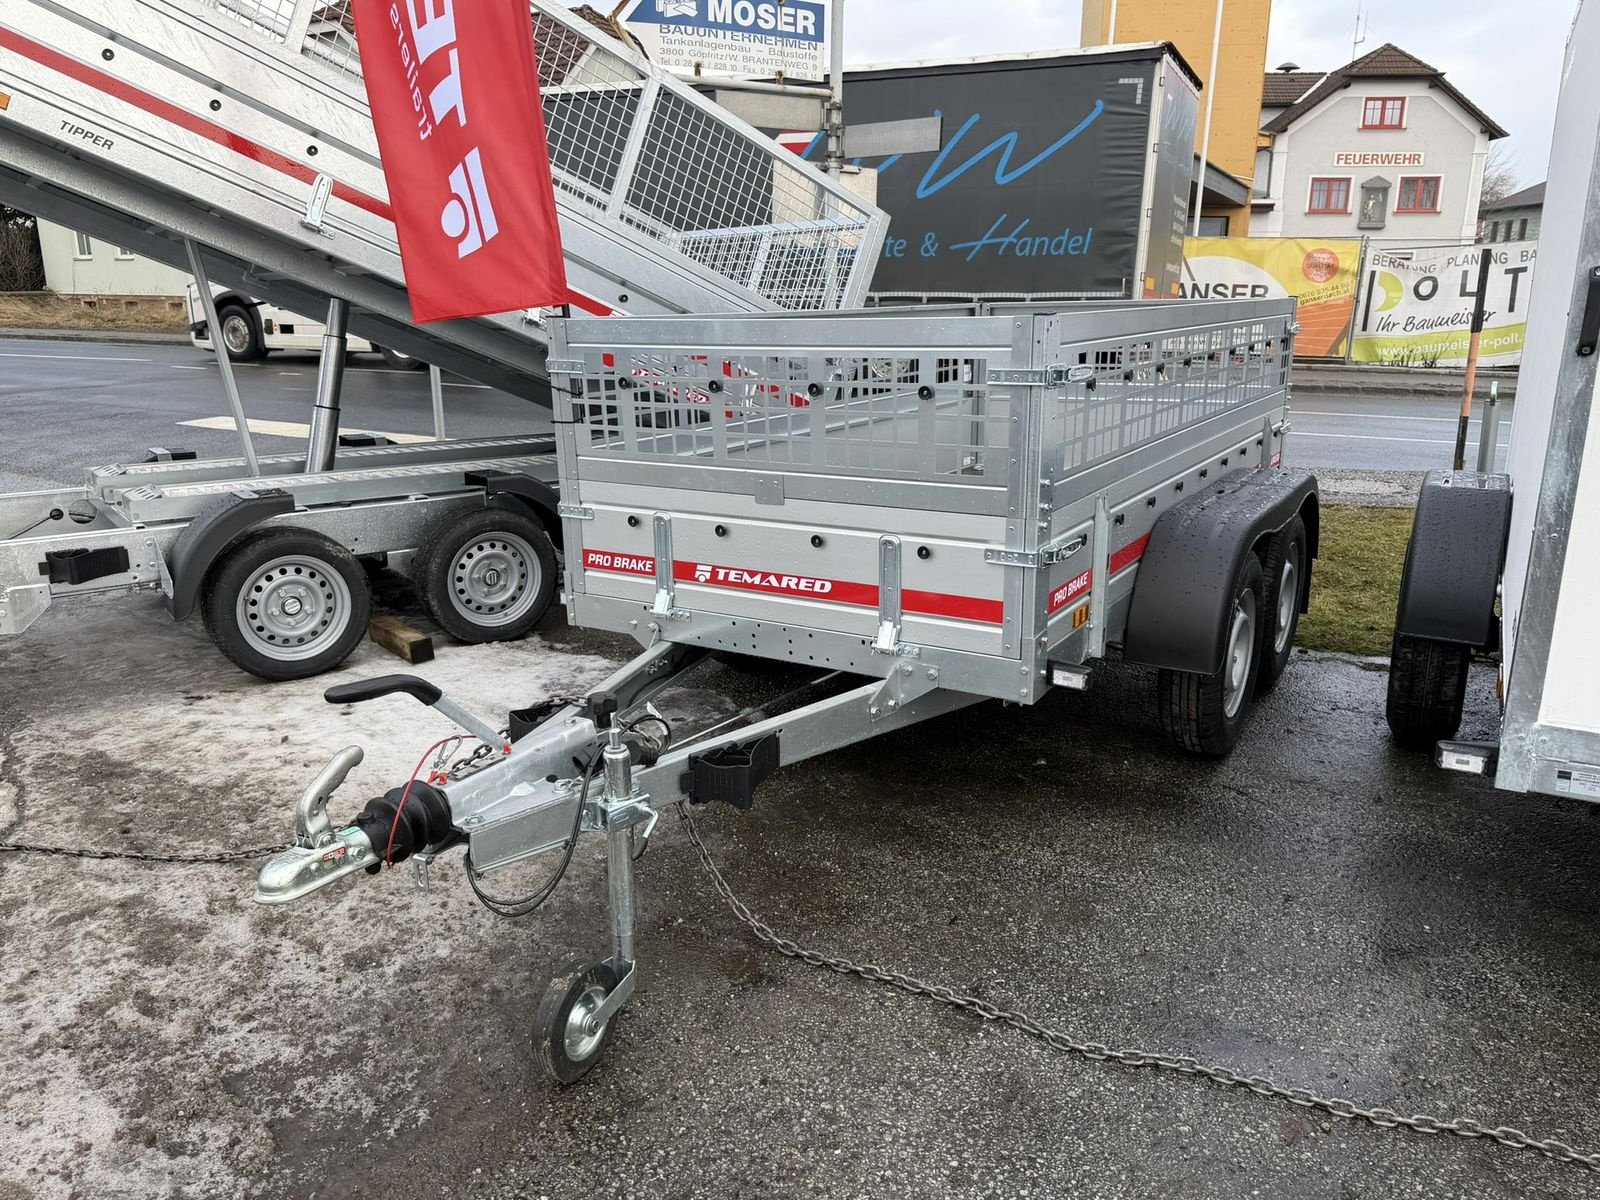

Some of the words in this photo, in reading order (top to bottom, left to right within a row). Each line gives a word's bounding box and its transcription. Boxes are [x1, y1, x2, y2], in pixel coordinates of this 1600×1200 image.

[707, 0, 817, 35] MOSER
[659, 25, 818, 51] BAUUNTERNEHMEN
[659, 36, 751, 53] Tankanlagenbau
[768, 47, 818, 61] Baustoffe
[660, 48, 684, 56] 3800
[742, 55, 809, 70] BRANTENWEG
[812, 63, 818, 72] 9
[60, 120, 114, 150] TIPPER
[1336, 153, 1422, 165] FEUERWEHR
[920, 231, 939, 258] &
[949, 213, 1093, 262] Handel
[1446, 251, 1509, 268] PLANNG
[1376, 314, 1401, 332] Ihr
[1402, 307, 1497, 332] Baumeiser
[587, 553, 611, 567] PRO
[613, 556, 654, 572] BRAKE
[715, 568, 832, 593] TEMARED
[1053, 585, 1068, 607] PRO
[1067, 571, 1089, 597] BRAKE
